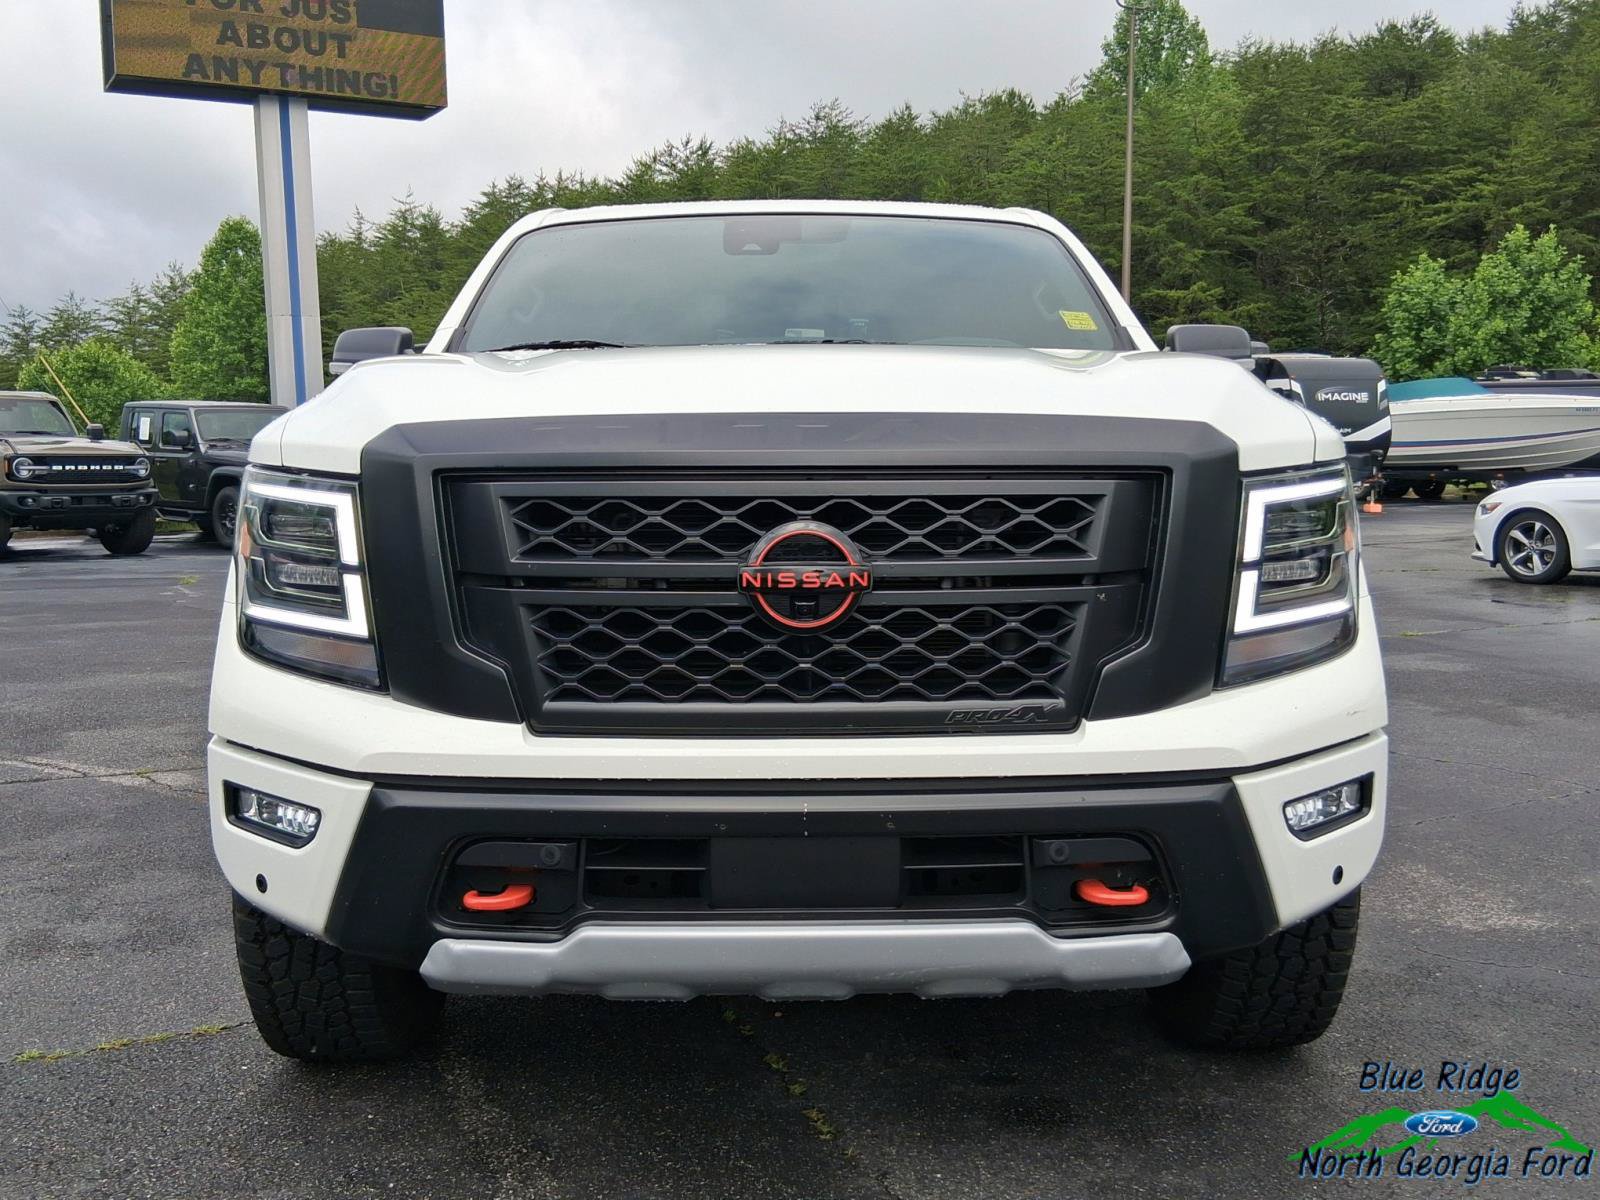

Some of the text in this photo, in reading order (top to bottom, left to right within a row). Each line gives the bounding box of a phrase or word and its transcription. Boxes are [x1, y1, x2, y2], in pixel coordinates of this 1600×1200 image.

[216, 20, 353, 59] ABOUT
[181, 53, 398, 98] ANYTHING!
[1318, 392, 1369, 401] IMAGINE
[741, 571, 869, 589] NISSAN
